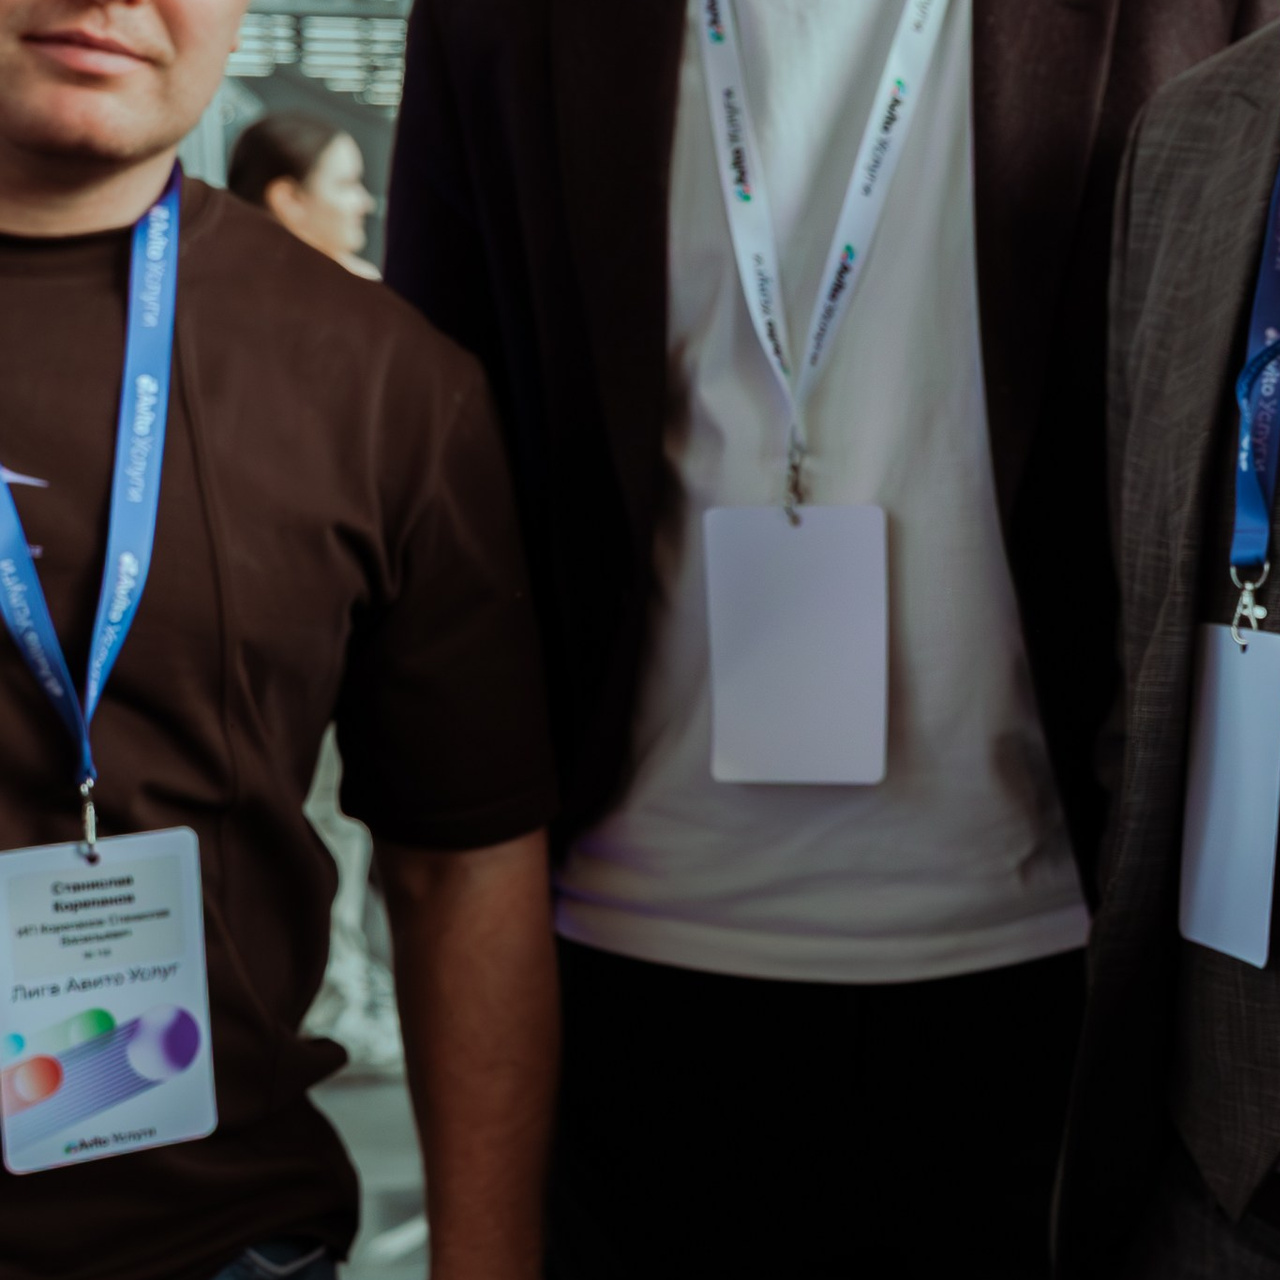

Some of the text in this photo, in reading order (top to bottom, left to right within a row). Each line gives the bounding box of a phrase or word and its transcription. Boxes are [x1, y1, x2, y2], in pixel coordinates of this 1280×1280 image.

[12, 963, 180, 1004] Лига Авито Услуг
